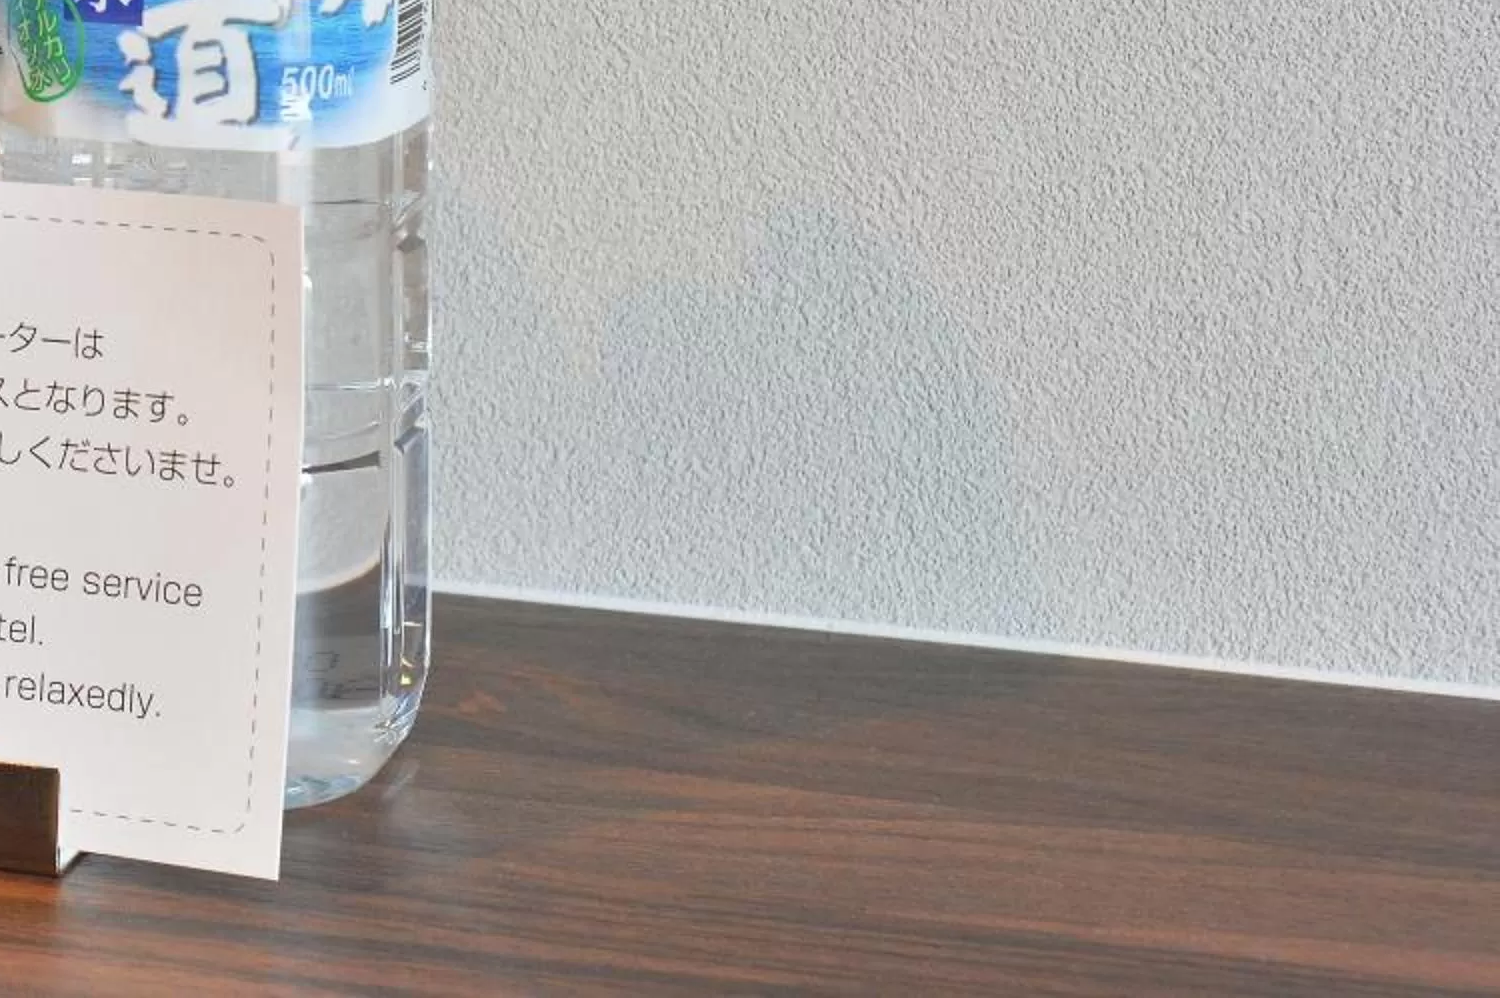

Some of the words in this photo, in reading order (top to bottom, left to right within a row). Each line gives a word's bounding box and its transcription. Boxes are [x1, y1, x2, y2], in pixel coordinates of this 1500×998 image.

[4, 555, 69, 593] free
[82, 570, 204, 608] service
[5, 670, 161, 720] relaxedly.
